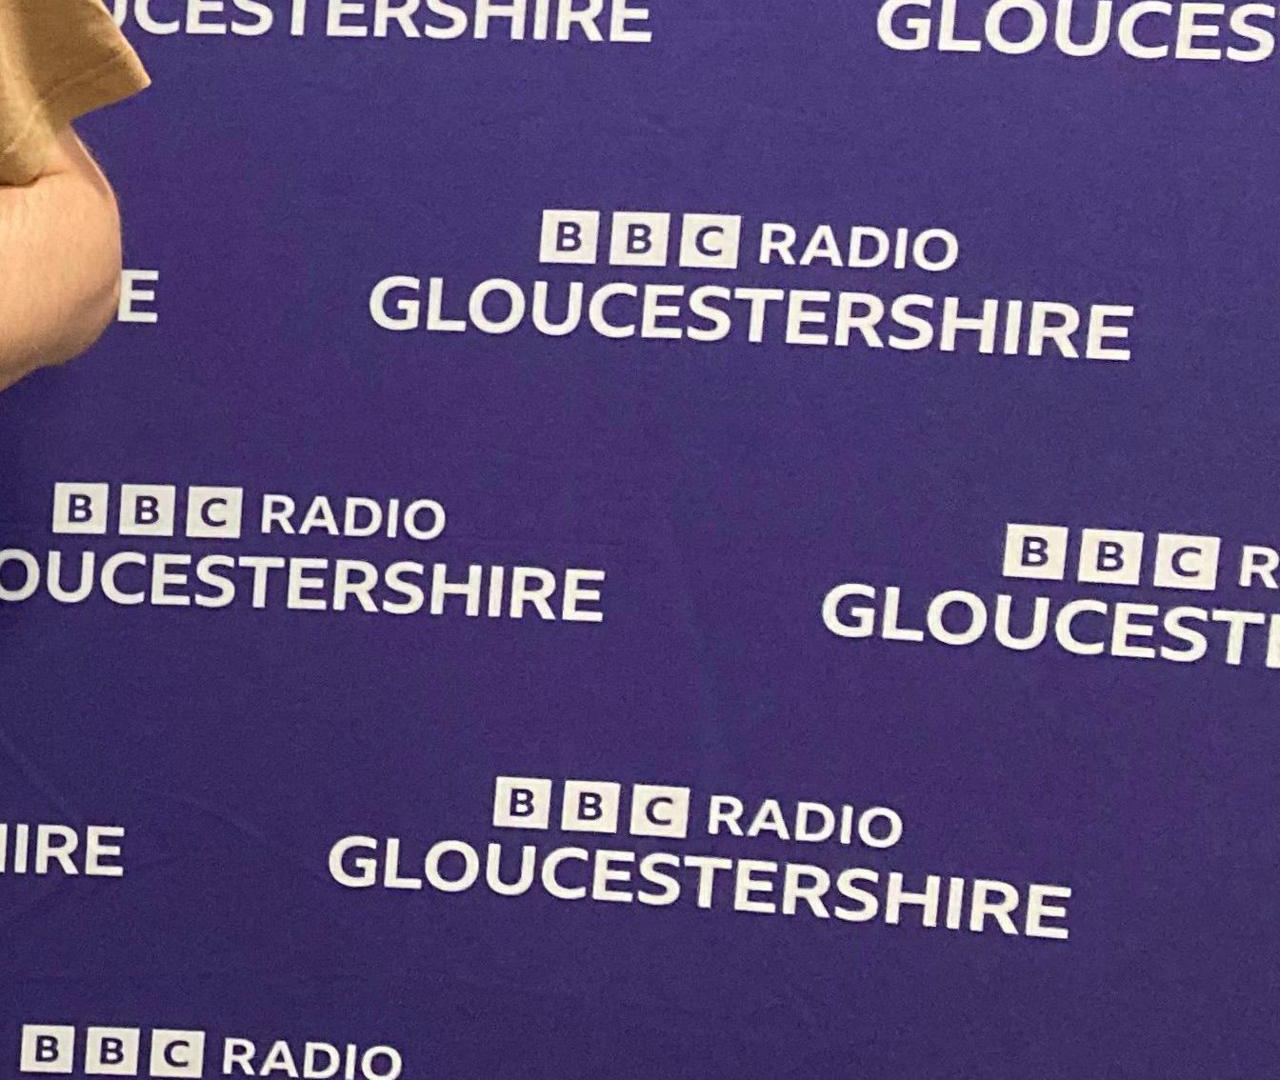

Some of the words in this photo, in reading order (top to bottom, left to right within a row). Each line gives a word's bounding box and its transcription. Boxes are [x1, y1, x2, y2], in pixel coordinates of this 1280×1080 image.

[553, 218, 728, 260] BBC
[760, 223, 958, 272] RADIO
[369, 276, 1134, 360] GLOUCESTERSHIRE
[64, 490, 231, 529] BBC
[262, 494, 445, 540] RADIO
[1017, 533, 1206, 581] BBC
[506, 785, 677, 829] BBC
[708, 796, 903, 849] RADIO
[329, 836, 1071, 939] GLOUCESTERSHIRE
[31, 1031, 194, 1071] BBC
[223, 1037, 402, 1080] RADIO
